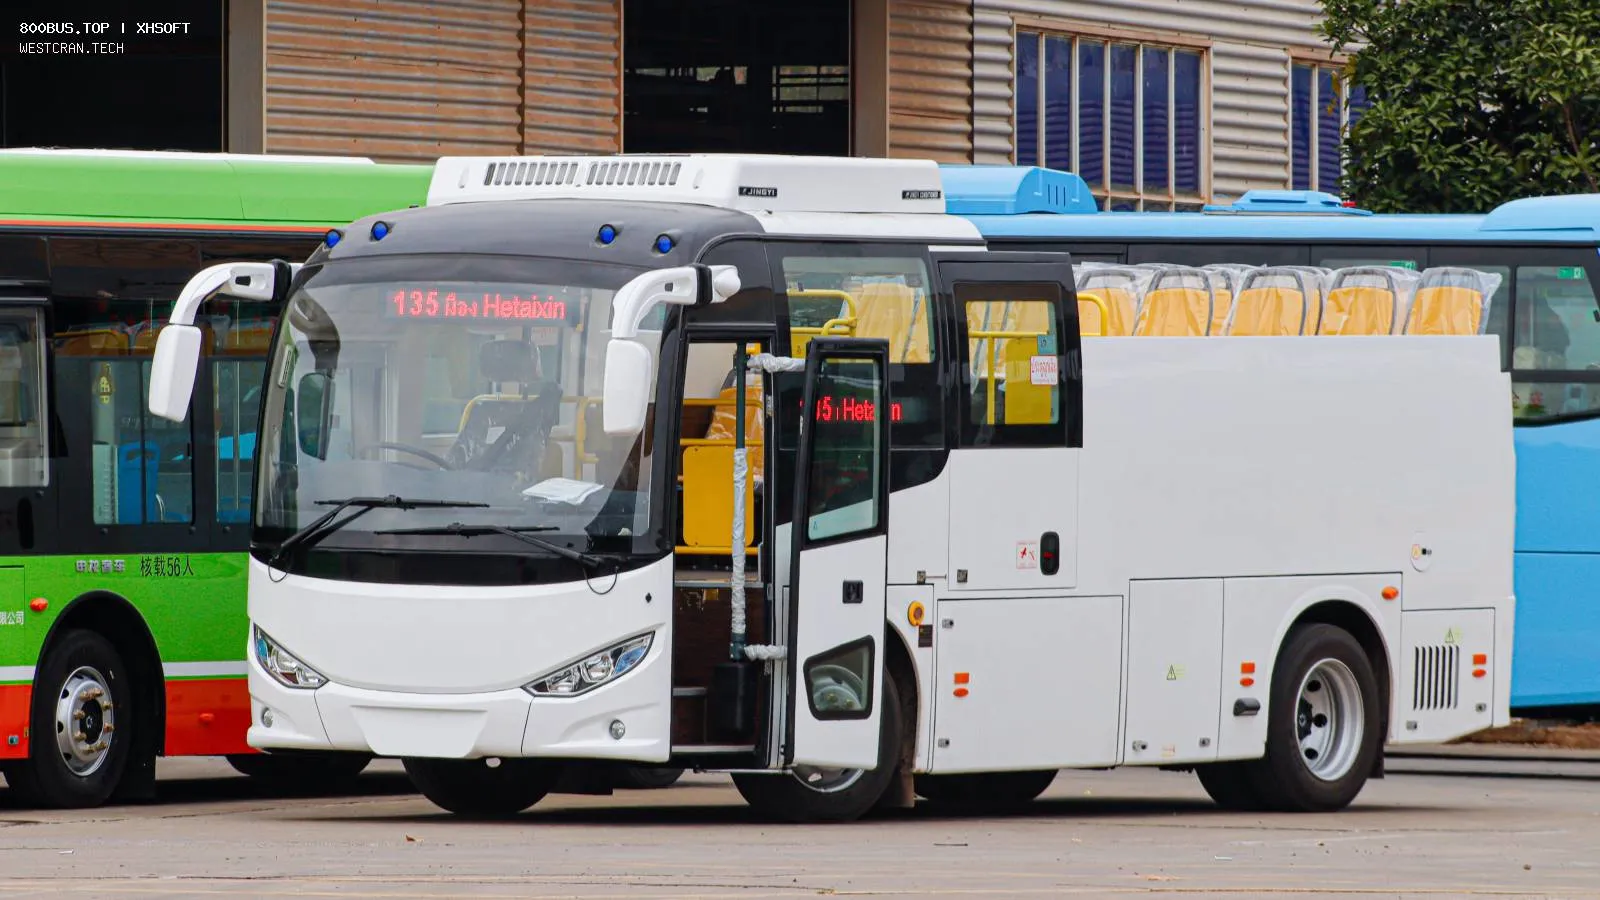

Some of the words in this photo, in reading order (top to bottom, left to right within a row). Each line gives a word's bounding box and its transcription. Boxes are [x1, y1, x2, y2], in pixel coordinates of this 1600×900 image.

[393, 289, 439, 316] 135
[483, 293, 566, 319] Hetaixin
[140, 555, 194, 577] 核载56人
